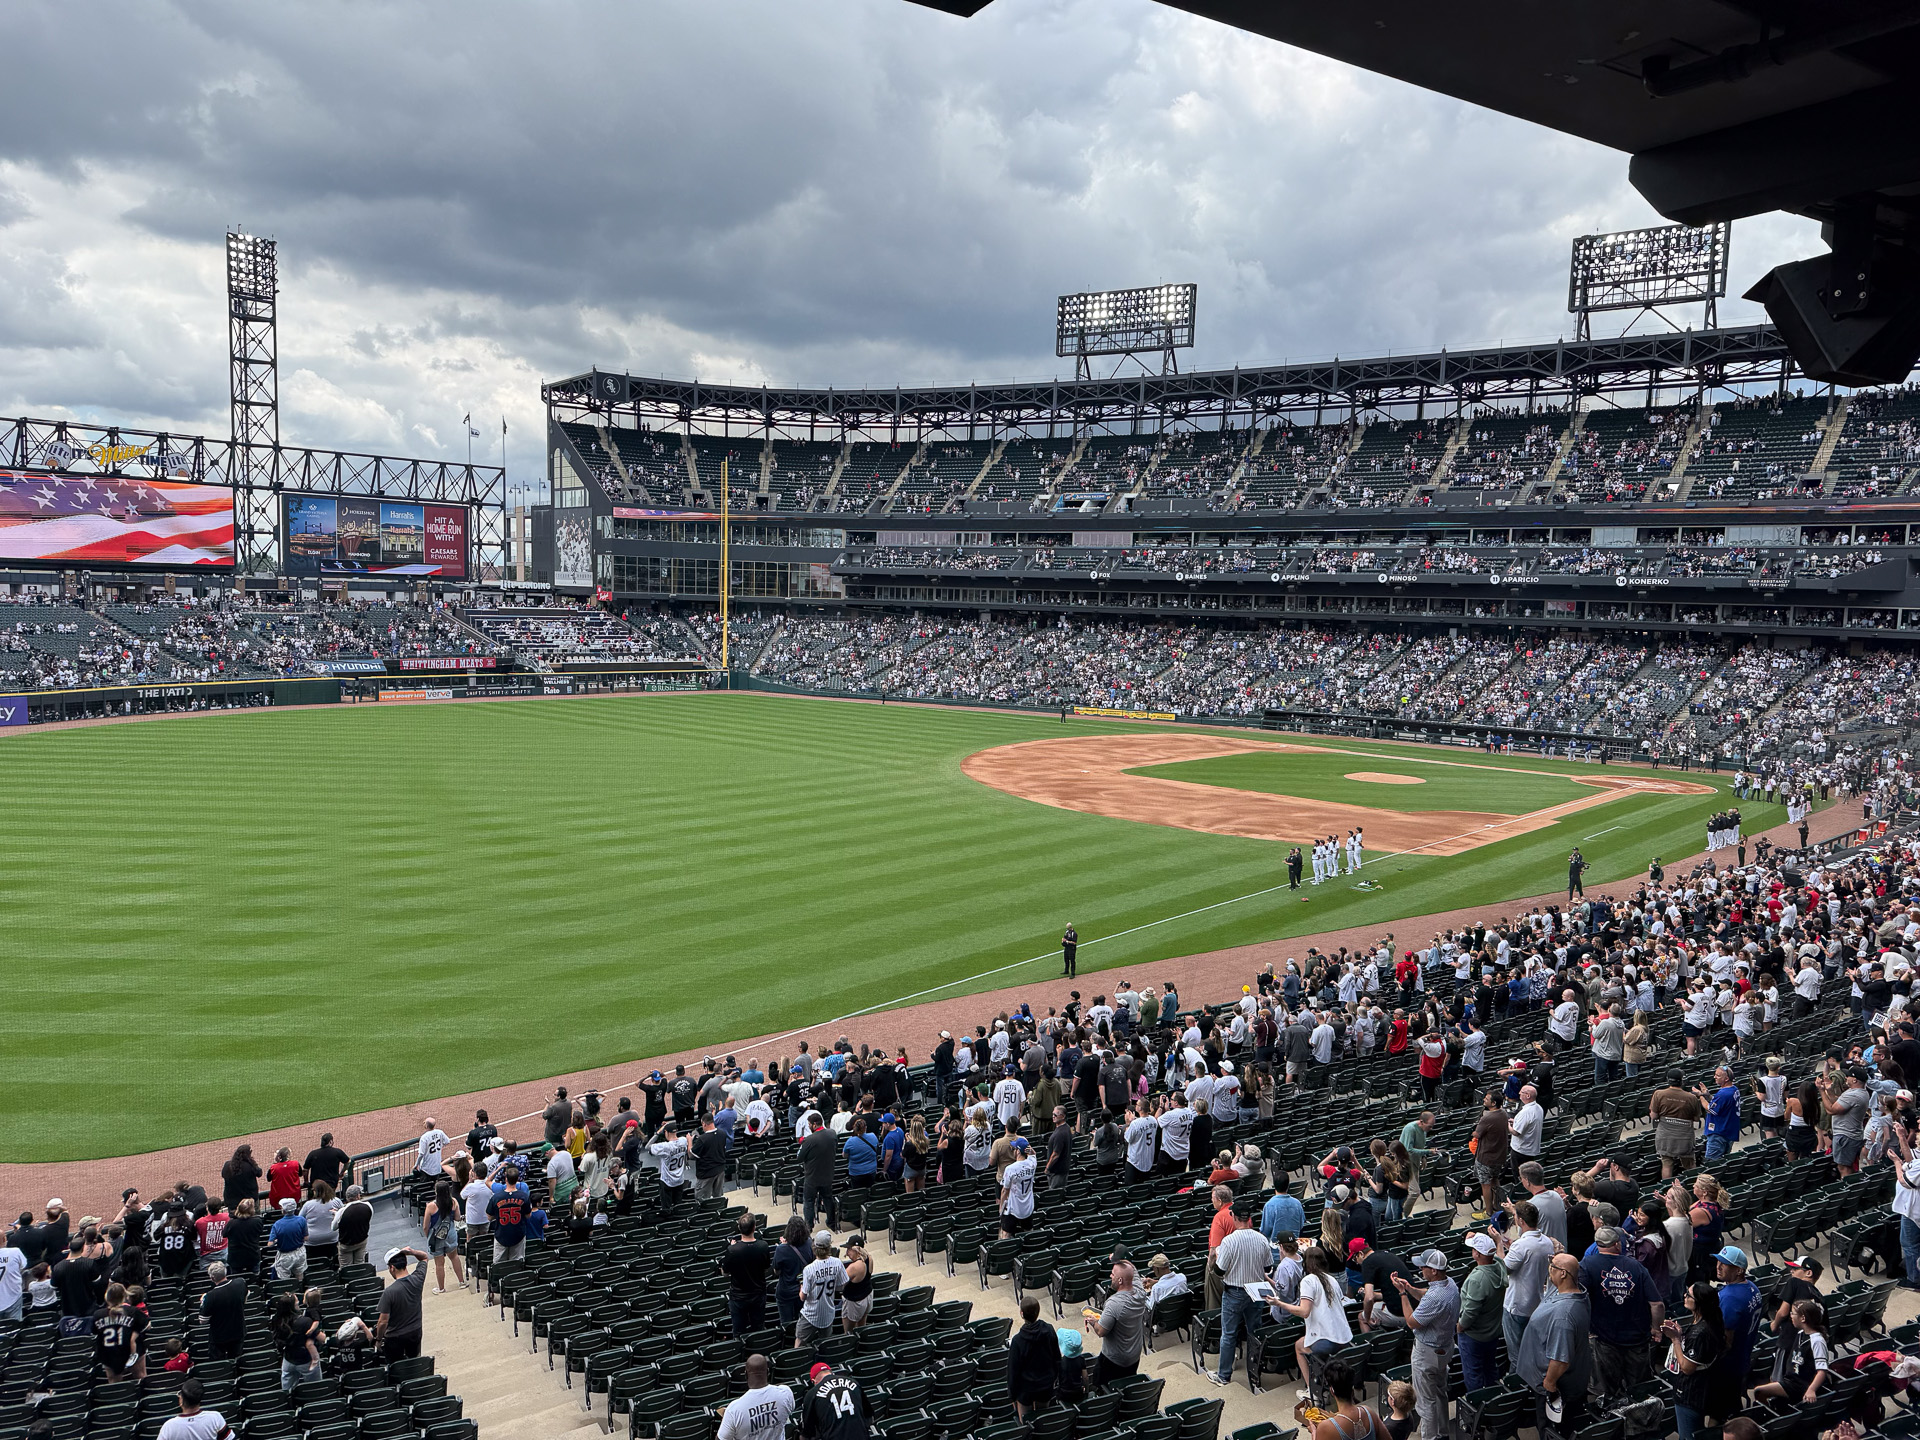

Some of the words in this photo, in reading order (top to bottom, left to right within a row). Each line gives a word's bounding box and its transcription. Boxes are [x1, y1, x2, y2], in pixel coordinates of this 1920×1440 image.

[49, 444, 70, 459] Lite
[88, 444, 152, 467] Miller
[139, 455, 167, 467] TIME
[167, 454, 187, 469] Lite
[390, 510, 415, 520] Harrah's
[426, 523, 446, 534] HOME
[447, 524, 462, 535] RUN
[434, 534, 454, 542] WITH
[331, 662, 382, 671] HYUNDAI
[402, 658, 457, 670] WHITTINGHAM
[459, 658, 484, 668] MEATS
[137, 688, 159, 698] THE
[161, 686, 193, 697] PATIO
[798, 1087, 810, 1099] 35
[1003, 1092, 1017, 1104] 50
[428, 1139, 442, 1155] 23
[975, 1132, 991, 1149] 25
[1145, 1131, 1153, 1147] 5
[669, 1155, 685, 1171] 20
[1020, 1178, 1032, 1195] 17
[499, 1206, 522, 1226] 55
[164, 1235, 185, 1250] 88
[815, 1279, 835, 1301] 79
[102, 1326, 124, 1347] 21
[341, 1352, 356, 1363] 88
[815, 1377, 858, 1400] KONERKO
[748, 1400, 778, 1418] DIETZ
[829, 1388, 855, 1420] 14
[750, 1410, 779, 1433] NUTS
